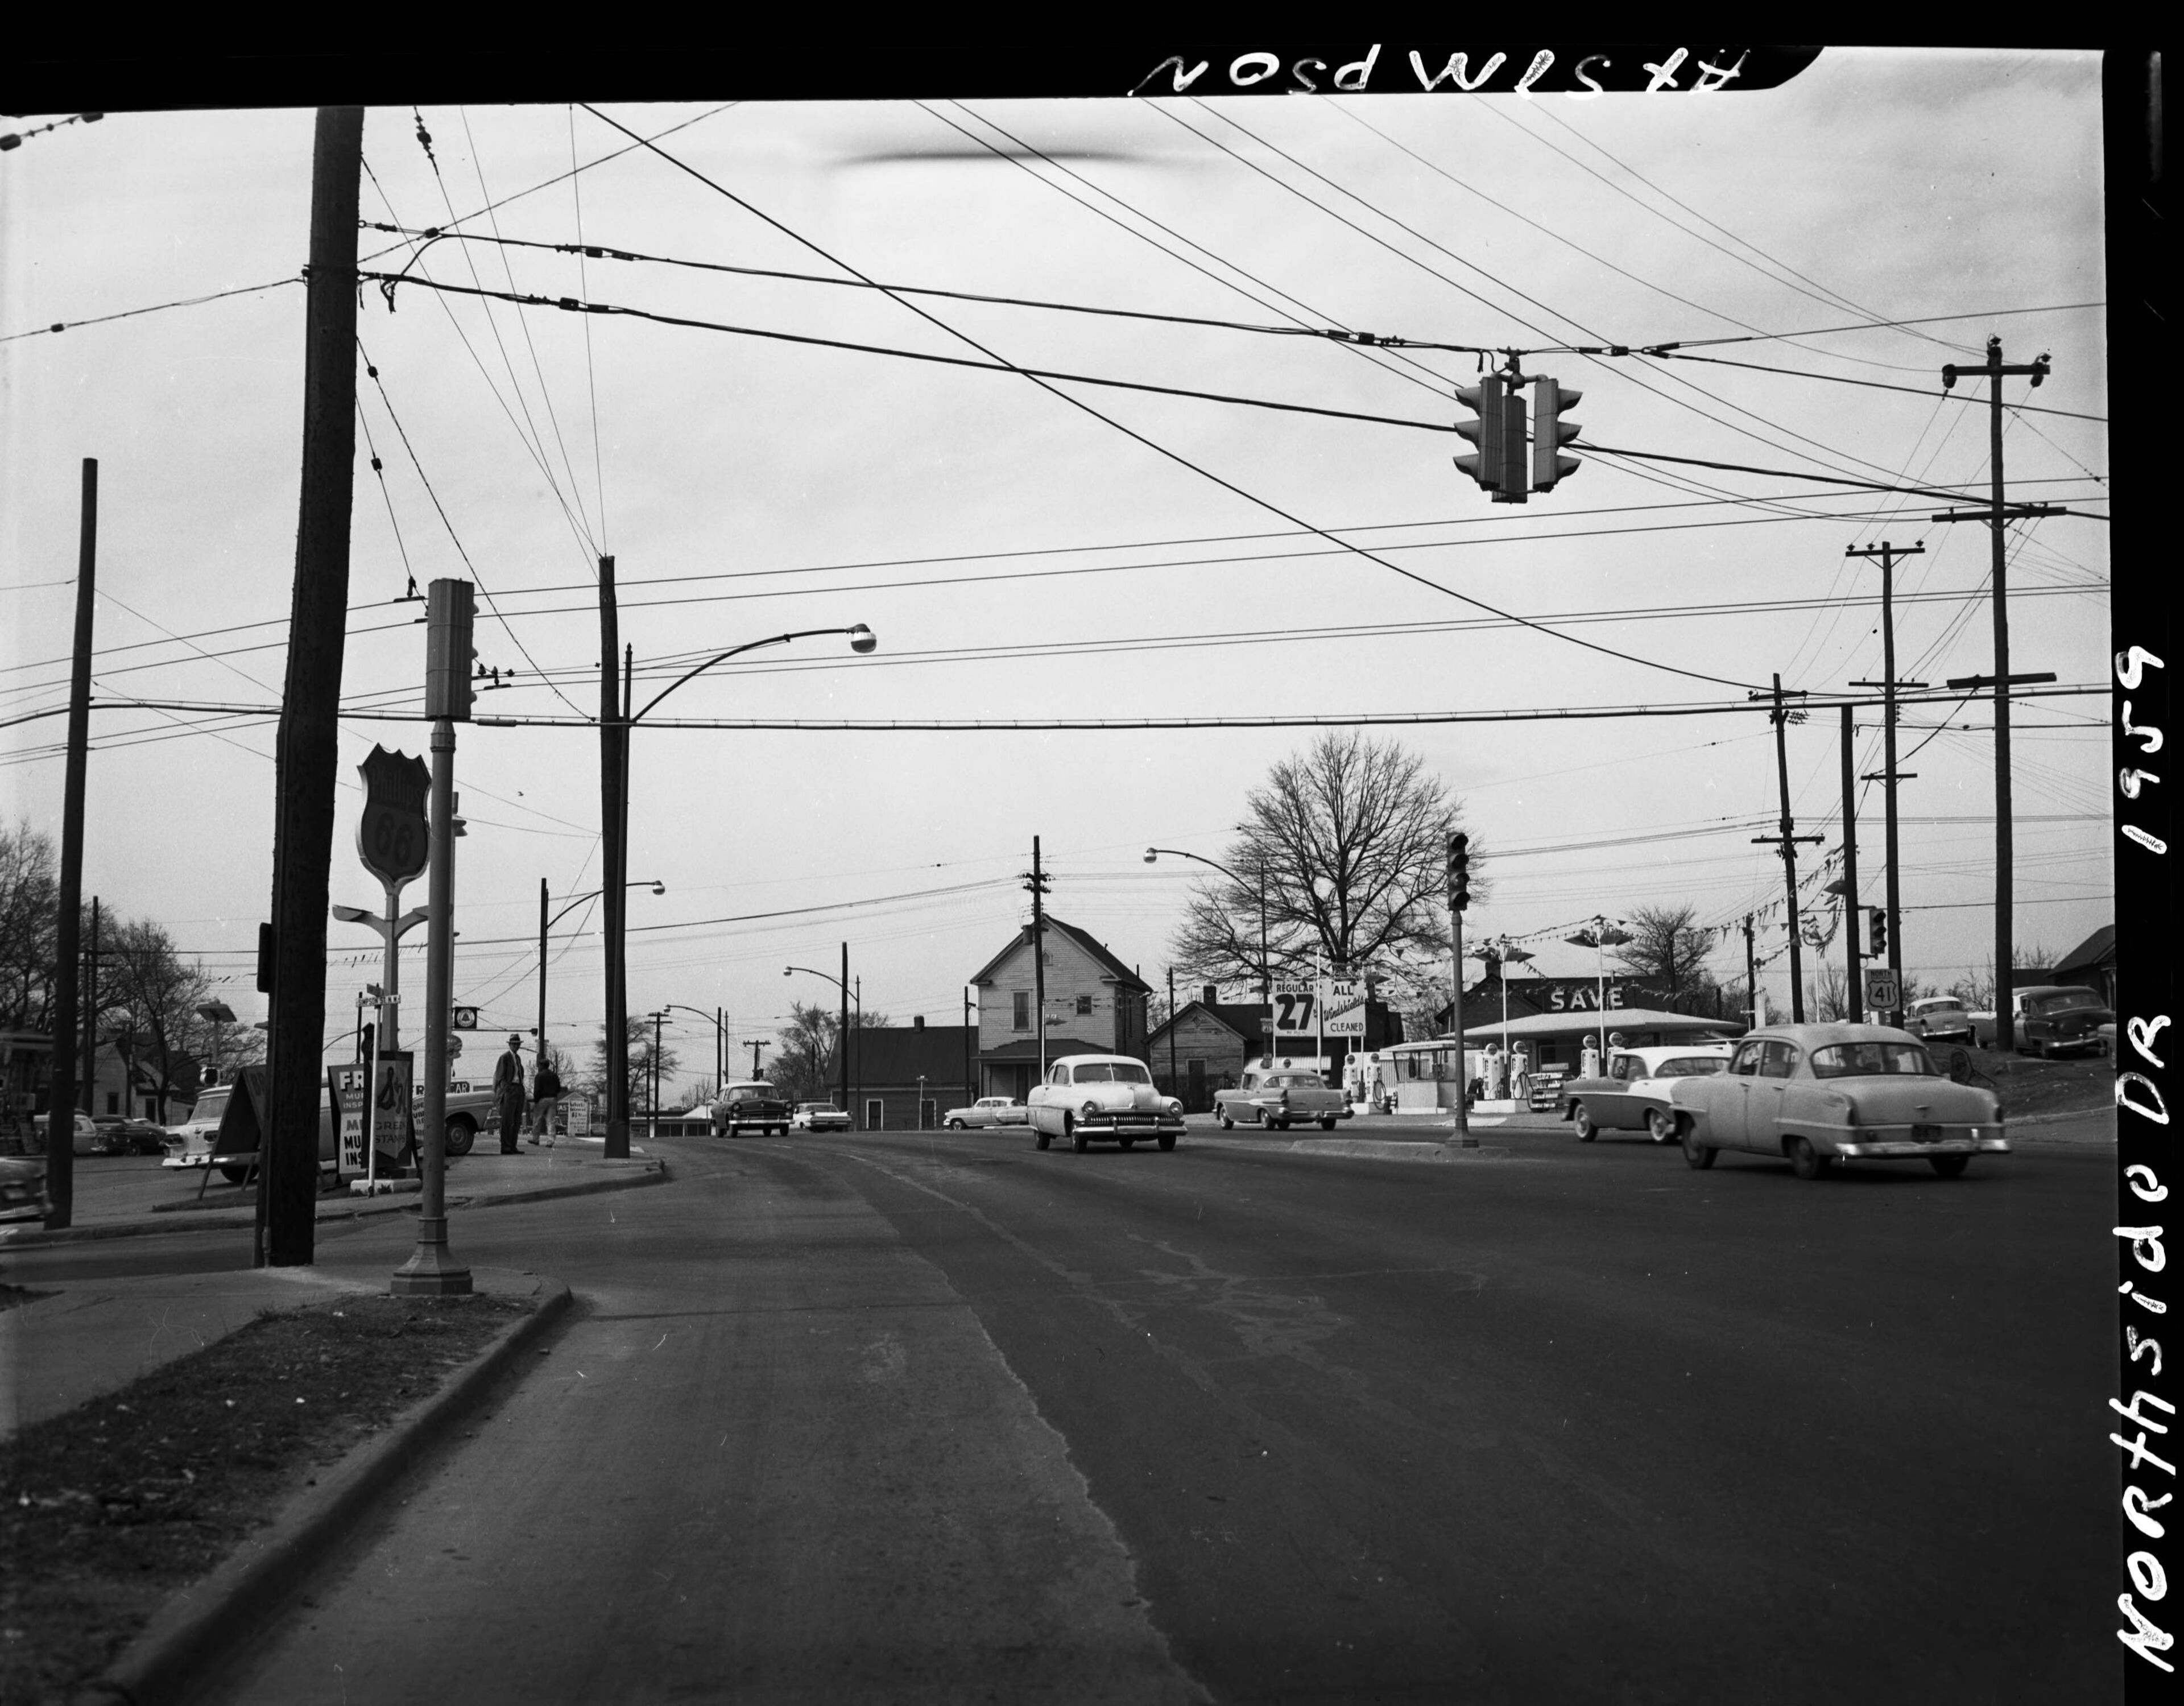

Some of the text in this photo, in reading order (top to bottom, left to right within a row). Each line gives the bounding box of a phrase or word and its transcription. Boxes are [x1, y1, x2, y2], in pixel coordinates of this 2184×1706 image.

[1276, 984, 1314, 993] REGULAR
[1333, 985, 1354, 995] ALL
[1875, 986, 1891, 1002] 41
[1551, 988, 1624, 1010] SAVE
[1275, 994, 1314, 1030] 27
[1323, 995, 1366, 1022] Windshields
[1330, 1023, 1363, 1032] CLEANED
